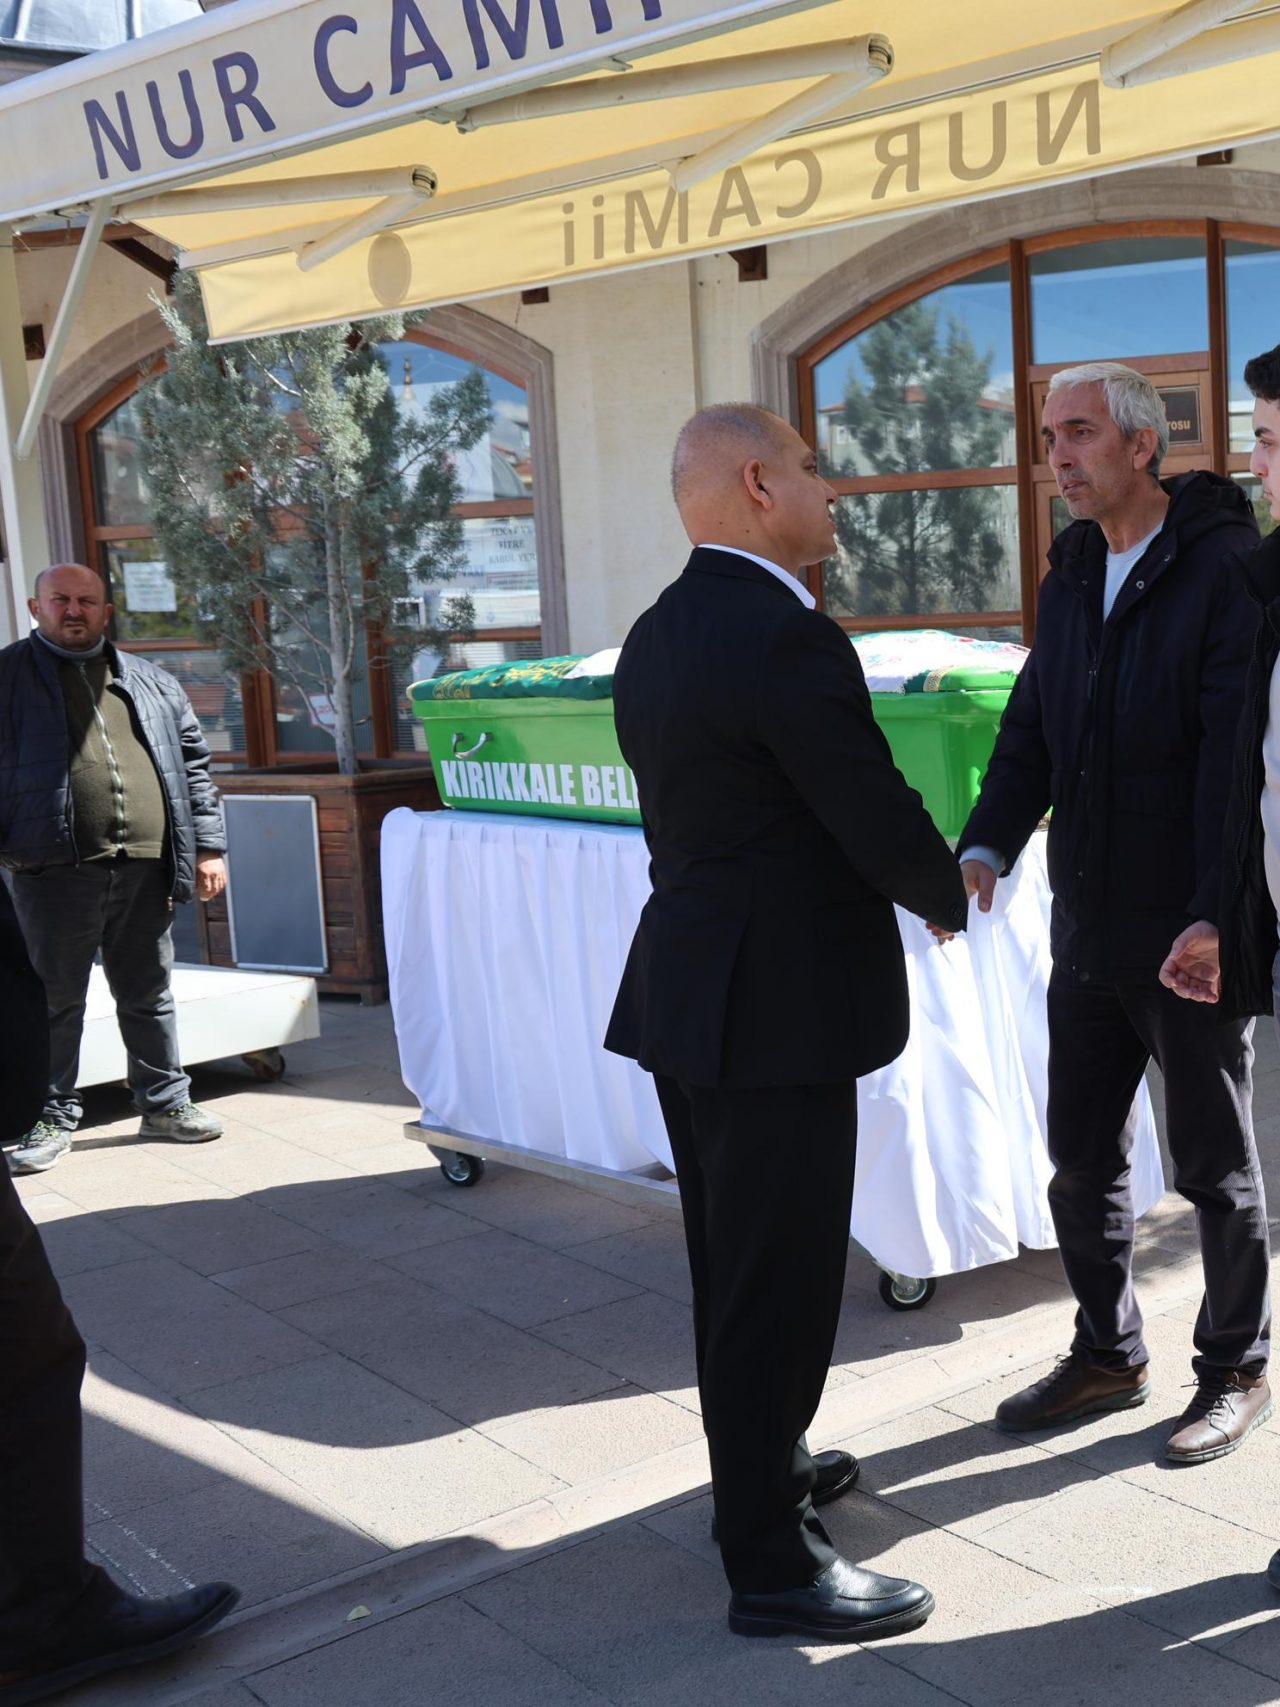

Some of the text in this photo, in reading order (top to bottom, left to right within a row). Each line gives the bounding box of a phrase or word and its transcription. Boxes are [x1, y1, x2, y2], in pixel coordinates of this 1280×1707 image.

[83, 0, 662, 179] NUR CAM
[440, 760, 577, 805] KIRIKKALE
